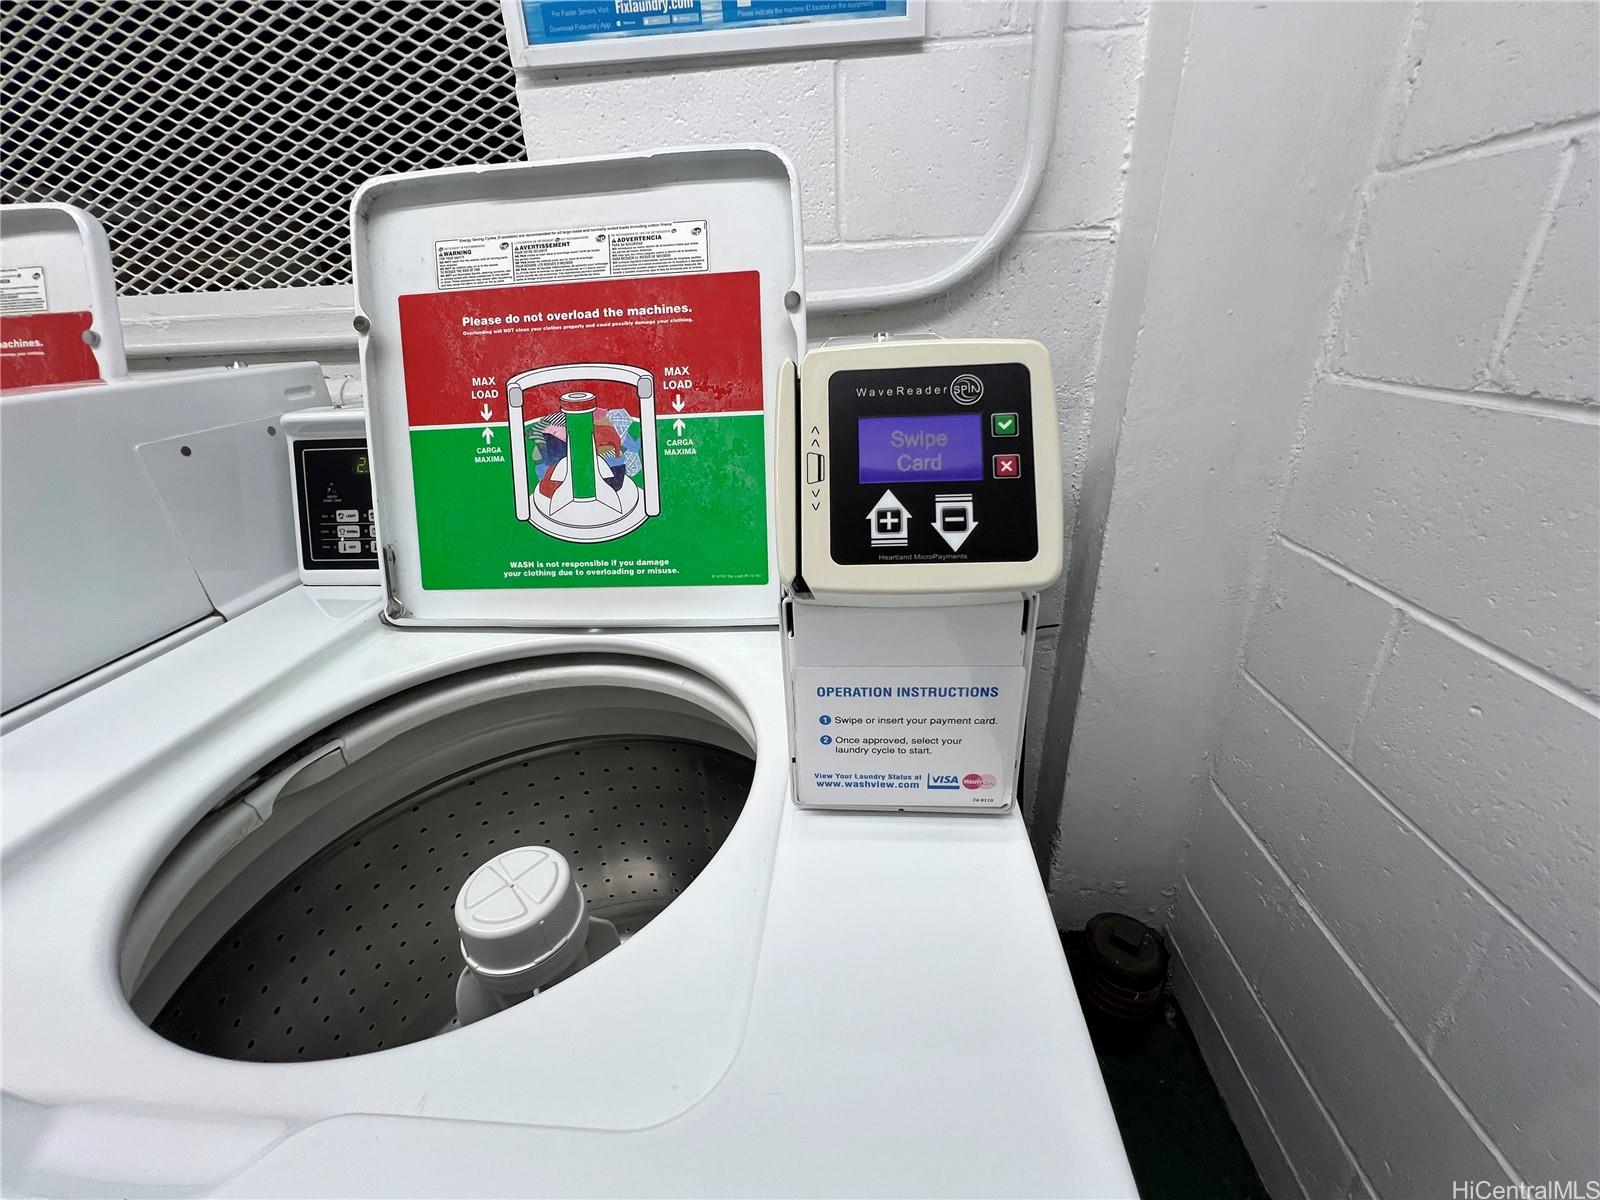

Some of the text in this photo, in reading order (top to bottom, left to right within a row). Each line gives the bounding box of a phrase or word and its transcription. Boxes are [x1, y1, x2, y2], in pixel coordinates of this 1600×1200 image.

[615, 0, 694, 14] Fixlaundry.com
[600, 22, 612, 30] App
[520, 242, 570, 250] AVERTISSEMENT
[462, 304, 692, 326] Please do not overload the machines.
[0, 339, 43, 348] achines.
[664, 366, 690, 376] MAX
[472, 377, 496, 386] MAX
[663, 381, 692, 390] LOAD
[472, 390, 498, 399] LOAD
[856, 385, 980, 397] WaveReader SPIN
[891, 430, 948, 449] Swipe
[897, 454, 942, 472] Card
[914, 553, 968, 561] MicroPayments
[562, 560, 609, 569] responsible
[636, 559, 669, 567] damage
[523, 570, 556, 578] clothing
[586, 568, 634, 576] overloading
[816, 687, 999, 698] OPERATION INSTRUCTIONS
[835, 717, 863, 725] Swipe
[906, 718, 927, 726] your
[930, 717, 971, 726] payment
[974, 717, 998, 725] card.
[862, 736, 908, 746] approved,
[835, 746, 869, 755] laundry
[872, 747, 895, 755] cycle
[816, 780, 919, 789] www.washview.com
[932, 776, 958, 784] VISA
